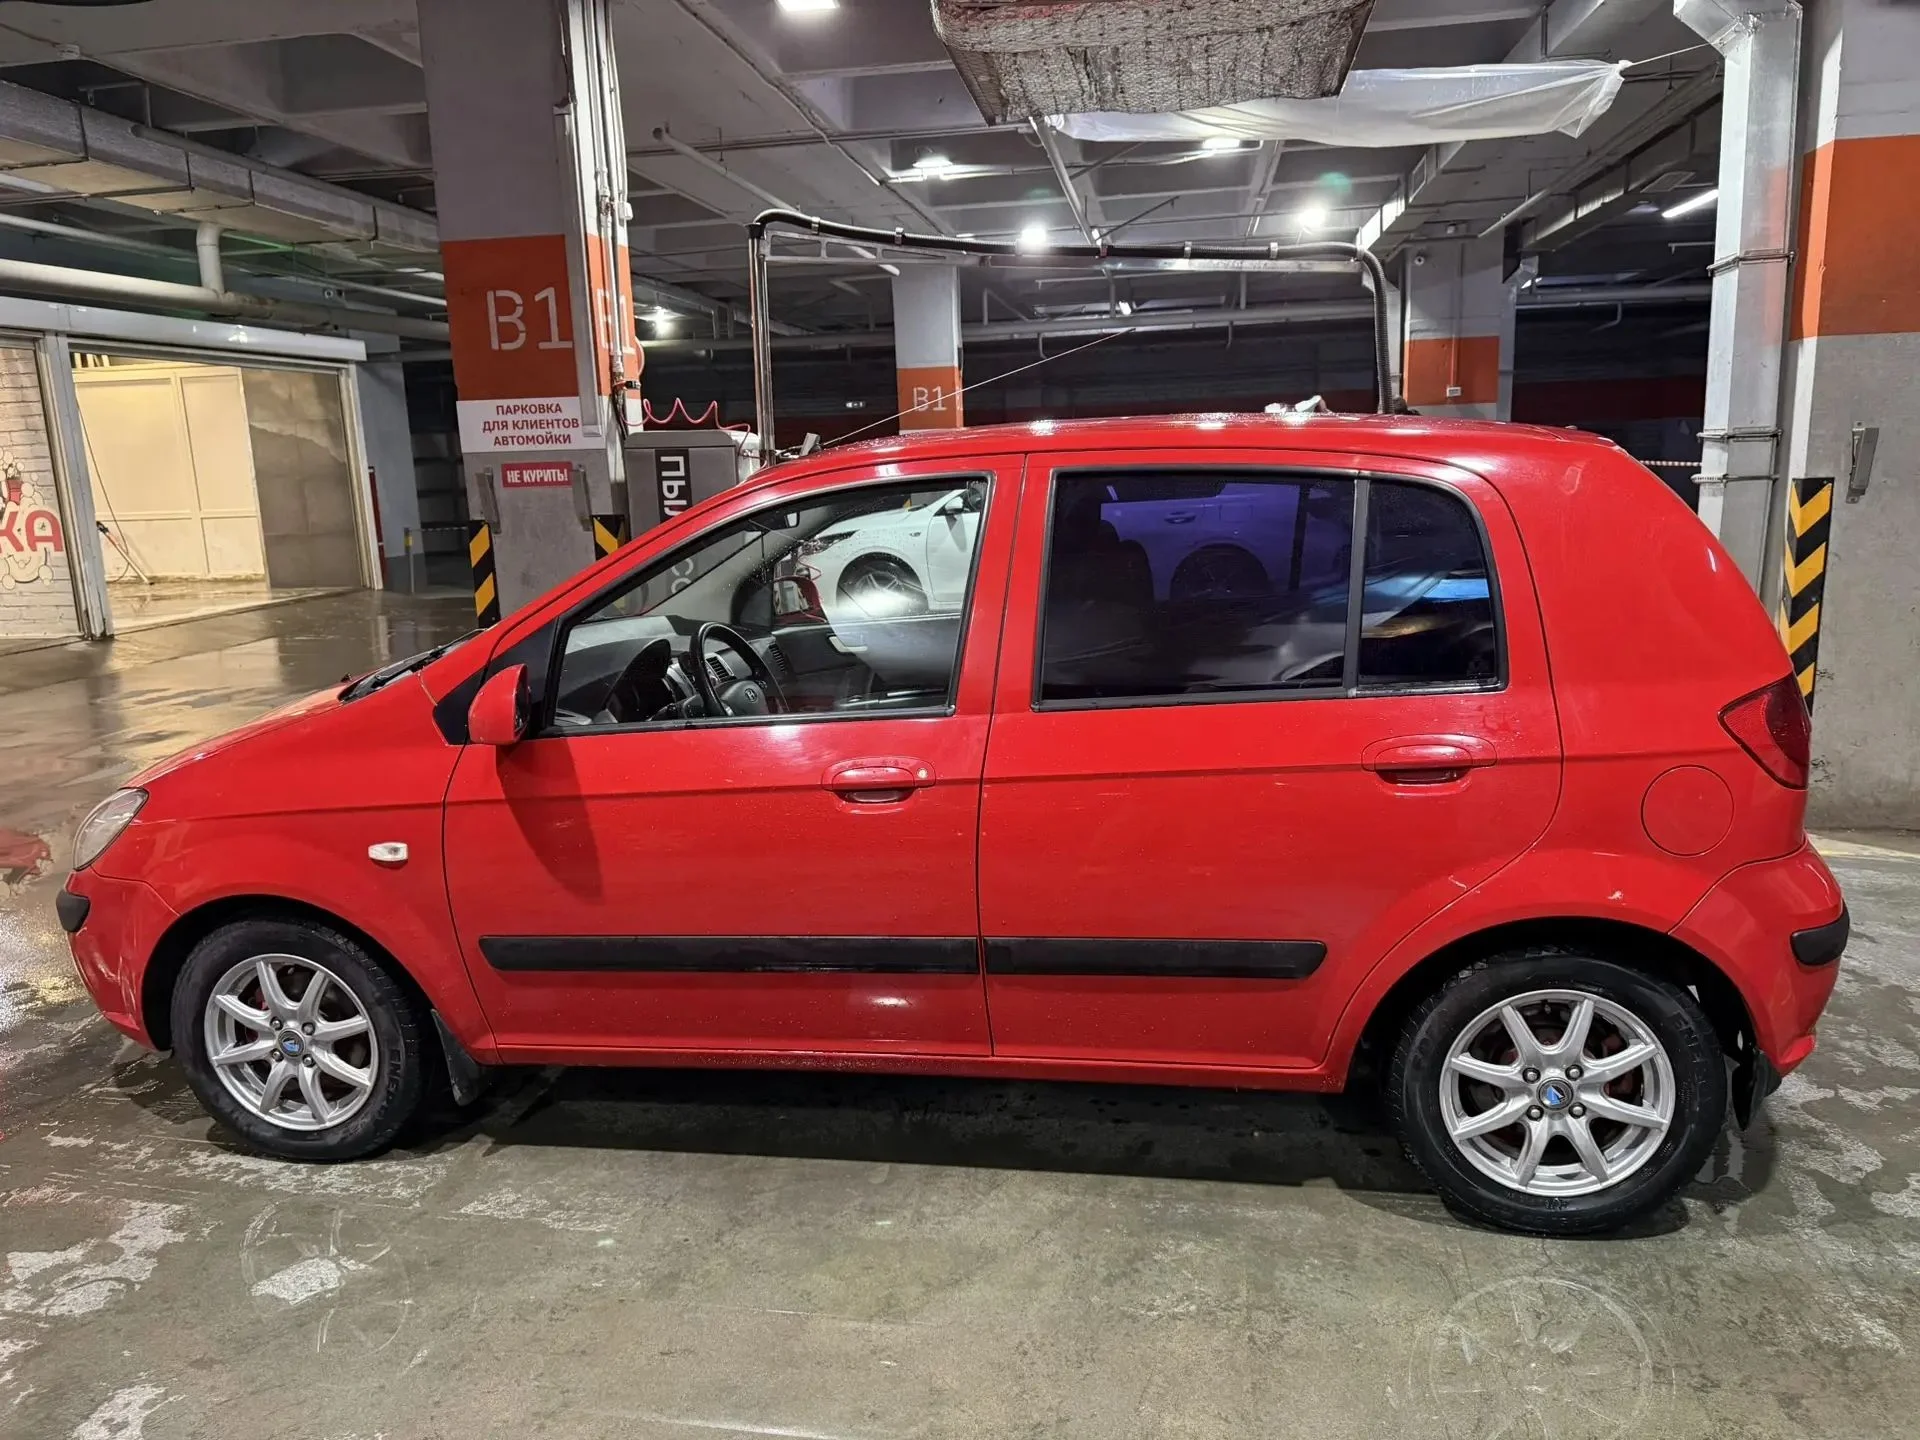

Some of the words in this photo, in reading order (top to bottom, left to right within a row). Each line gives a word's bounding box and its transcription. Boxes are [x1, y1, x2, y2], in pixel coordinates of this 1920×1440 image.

[486, 287, 573, 350] B1
[913, 386, 947, 411] B1
[496, 403, 562, 415] ПАРКОВКА
[482, 421, 509, 433] ДЛЯ
[512, 418, 579, 430] КЛИЕНТОВ
[494, 432, 571, 446] АВТОМОЙКИ
[507, 470, 520, 483] НЕ
[523, 469, 568, 482] КУРИТЬ!
